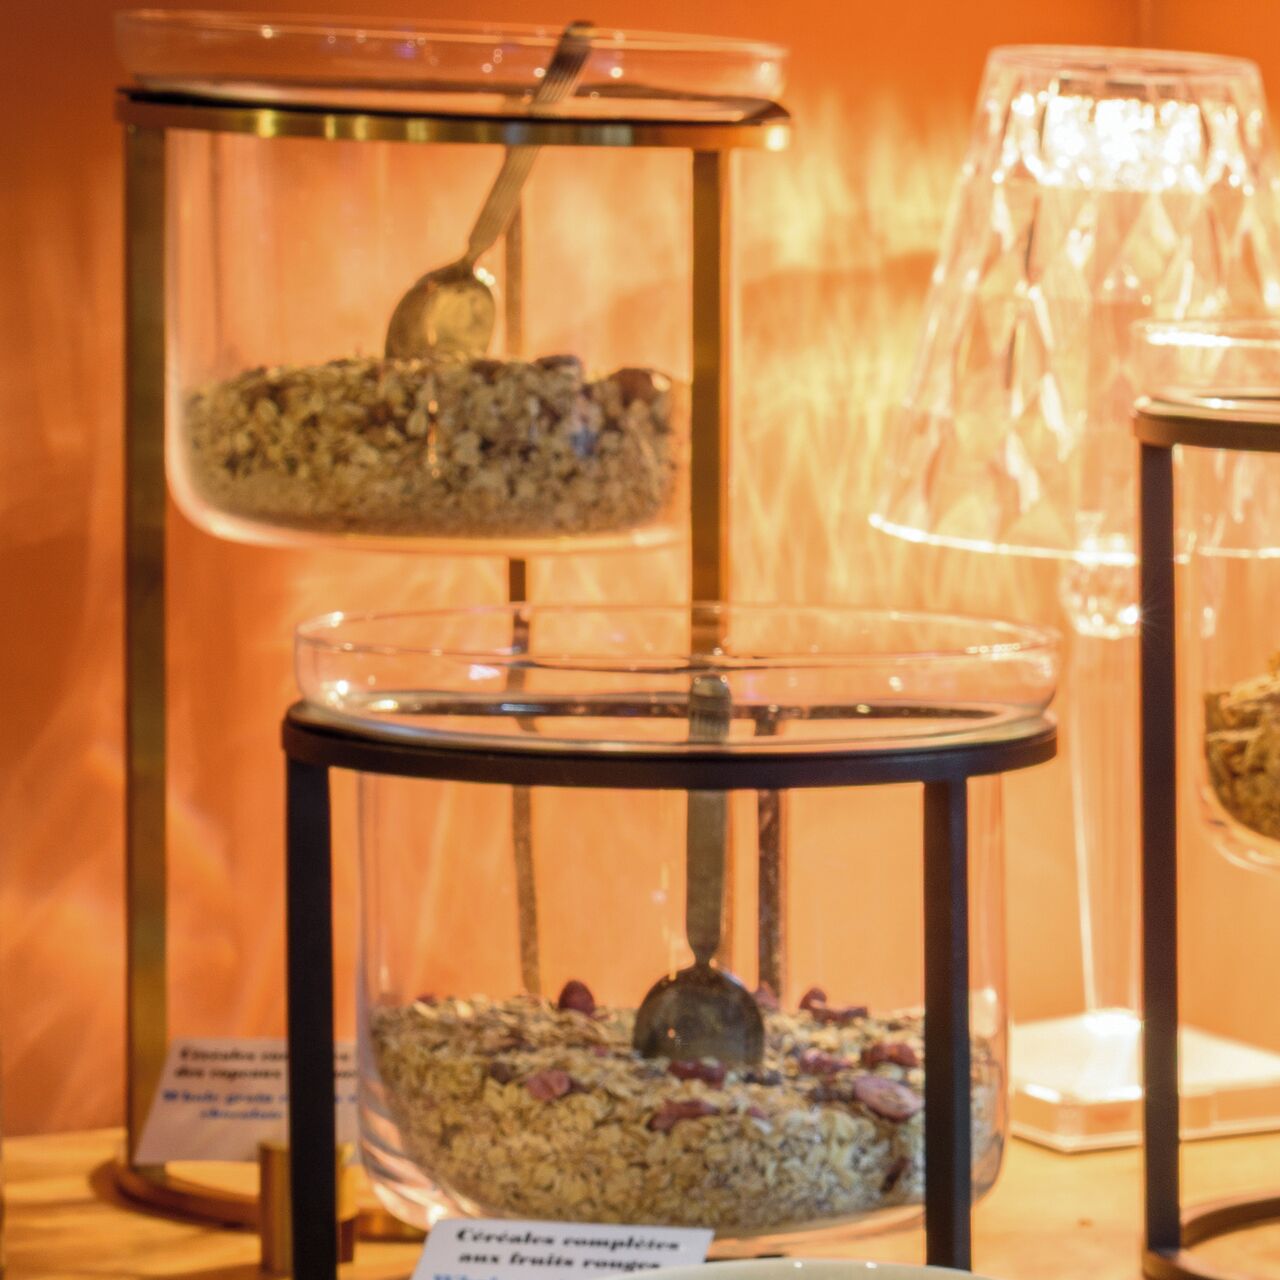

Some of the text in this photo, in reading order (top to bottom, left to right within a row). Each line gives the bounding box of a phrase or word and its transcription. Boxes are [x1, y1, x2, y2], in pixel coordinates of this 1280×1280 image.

[456, 1227, 680, 1251] Céréales complètes
[459, 1252, 661, 1272] aux fruits rouges
